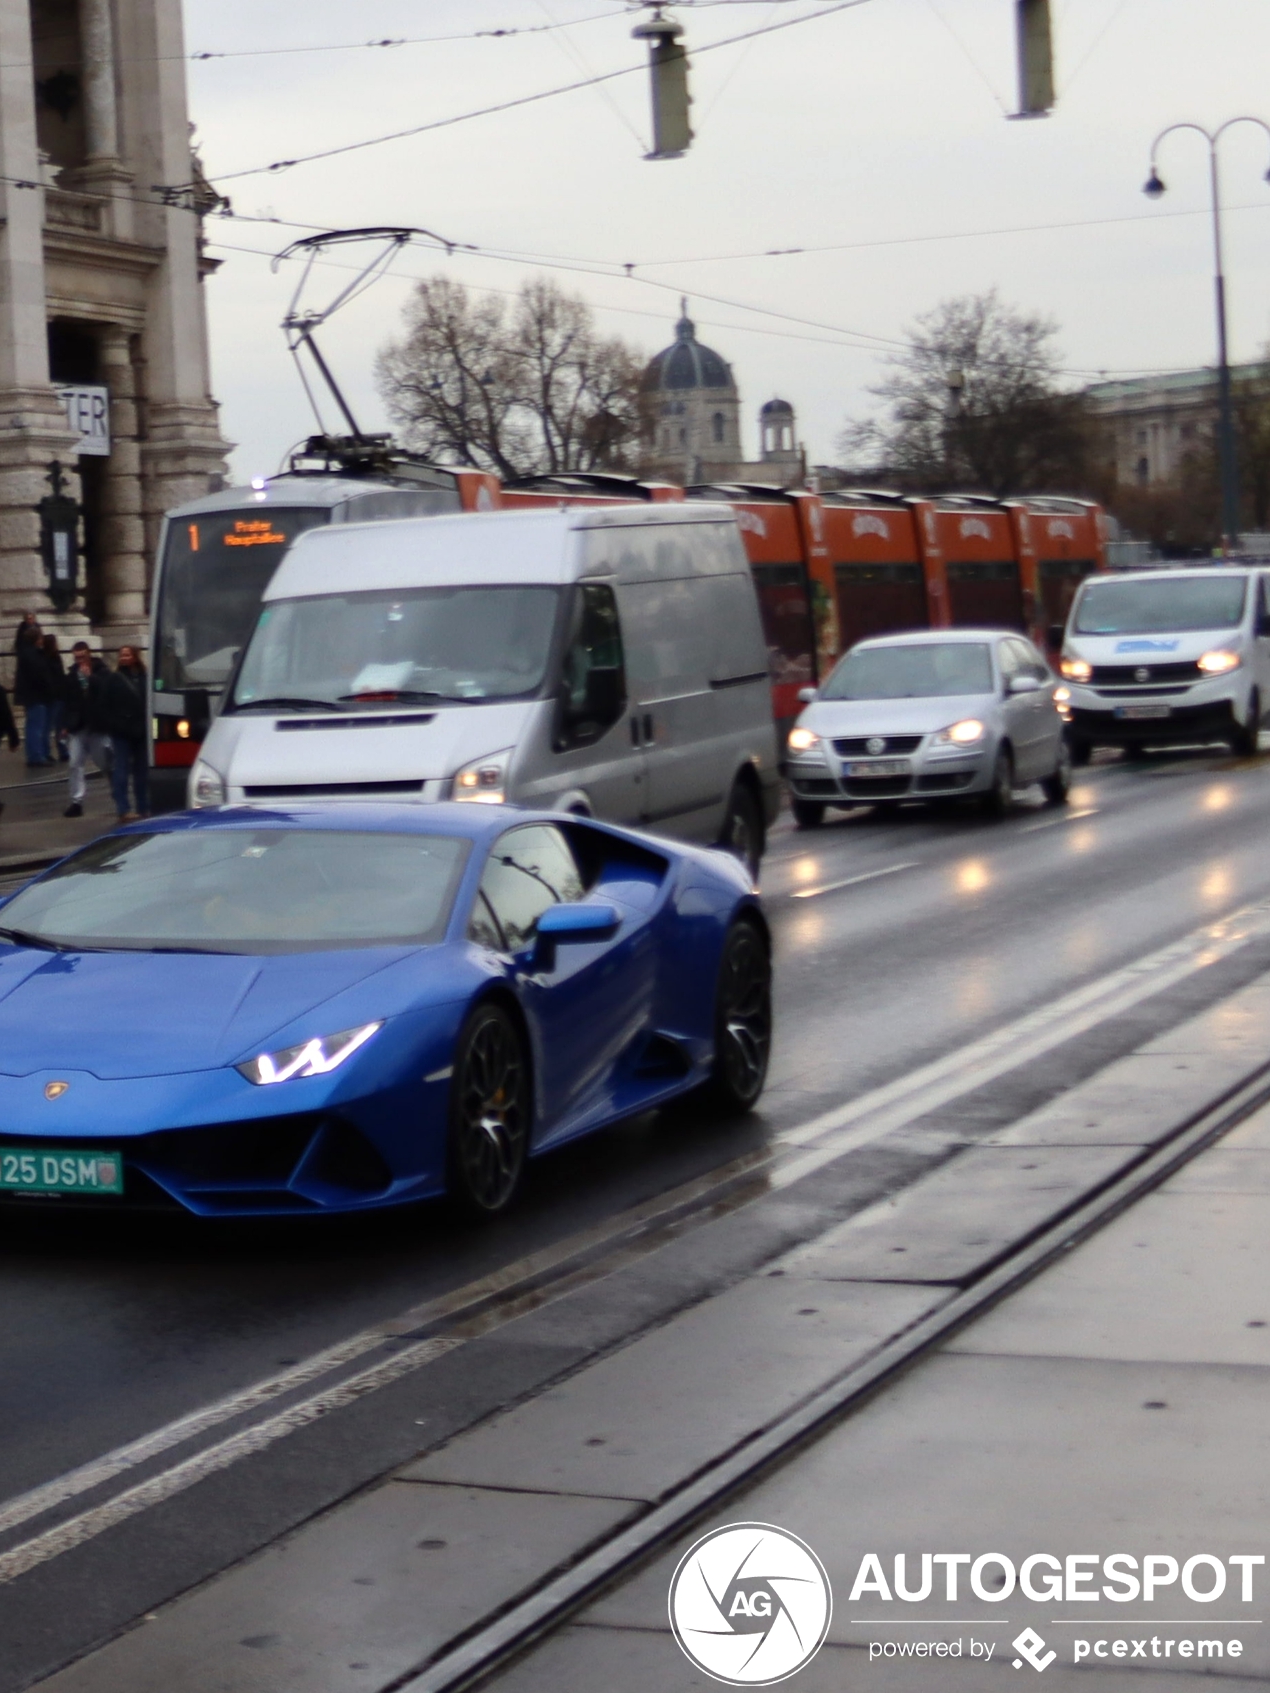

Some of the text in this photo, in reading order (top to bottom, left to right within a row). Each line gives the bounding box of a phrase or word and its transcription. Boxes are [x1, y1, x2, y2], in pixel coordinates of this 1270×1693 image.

[61, 393, 106, 437] TER
[189, 524, 199, 551] 1
[3, 1155, 37, 1183] 25
[43, 1157, 98, 1186] DSM
